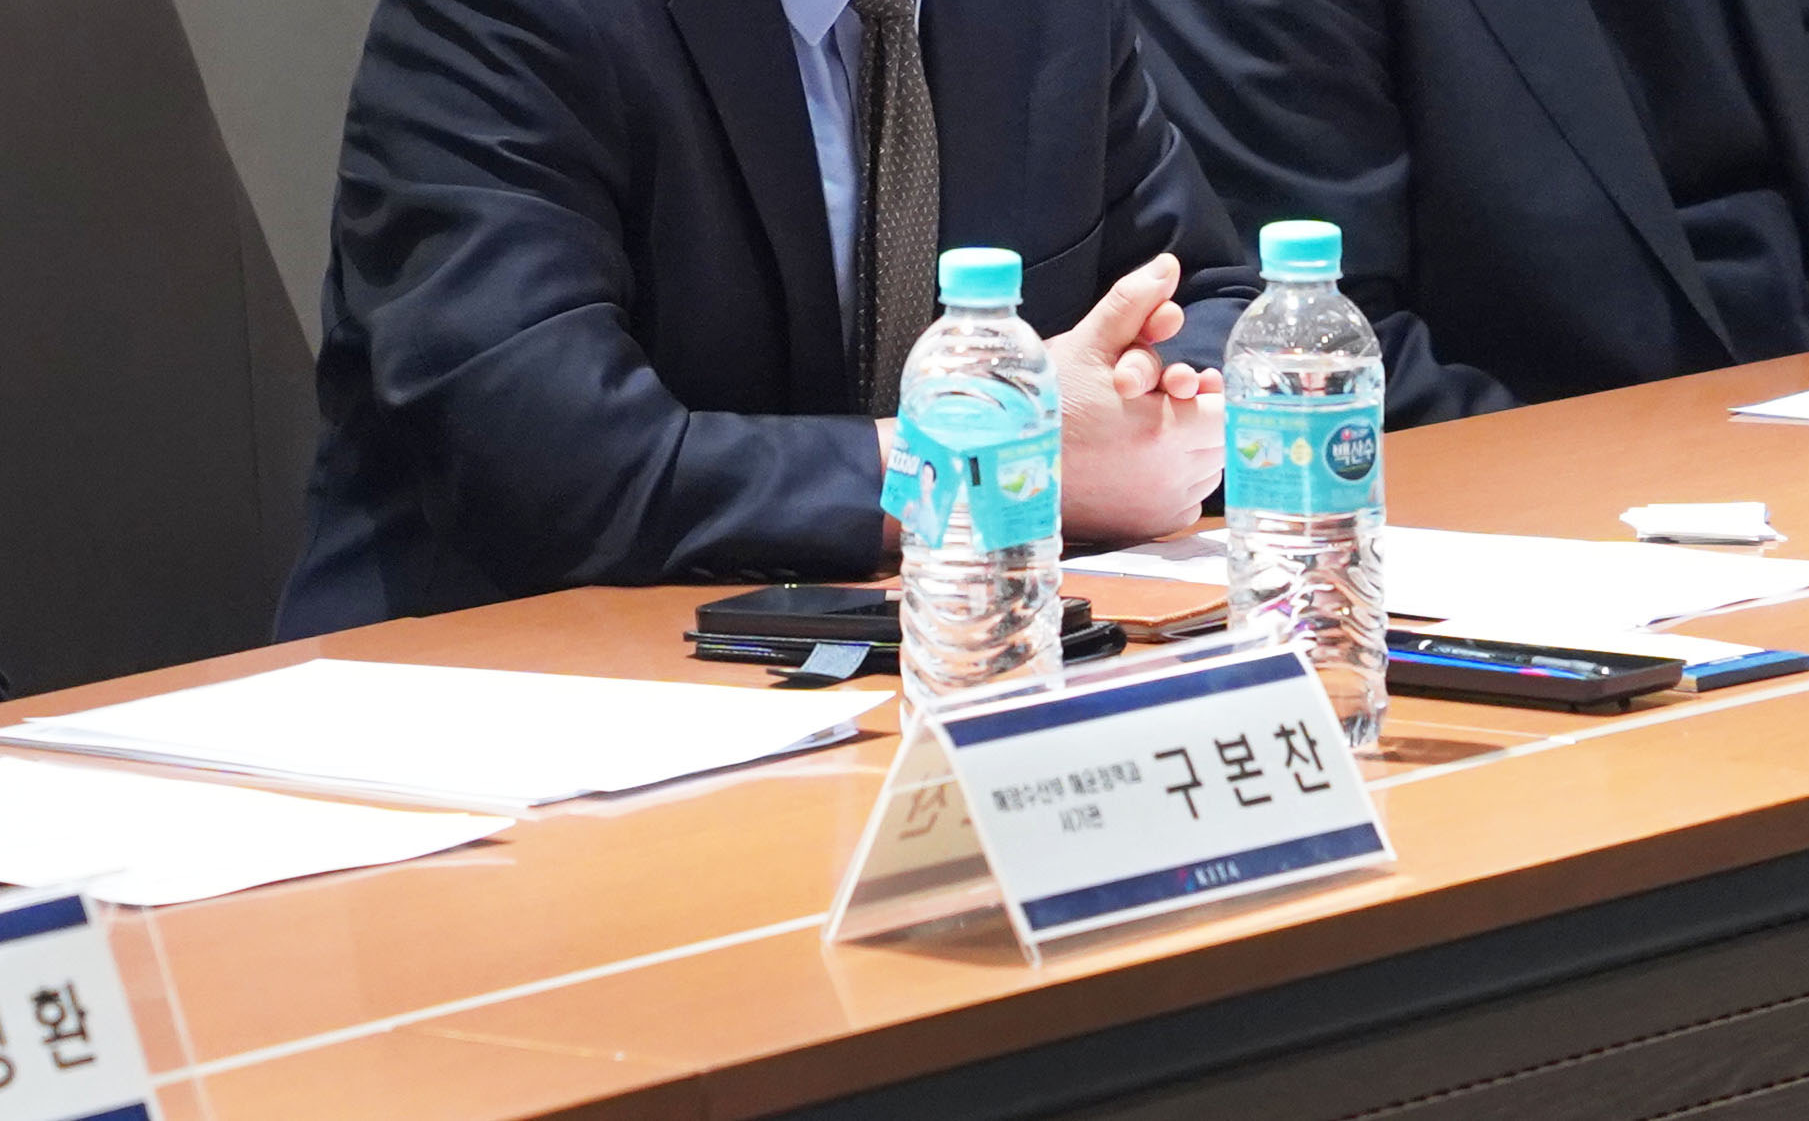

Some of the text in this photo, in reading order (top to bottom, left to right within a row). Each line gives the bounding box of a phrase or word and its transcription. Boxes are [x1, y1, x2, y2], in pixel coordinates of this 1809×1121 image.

[1332, 438, 1375, 466] 백산수
[1153, 720, 1332, 820] 구본찬
[1193, 859, 1241, 887] KITA
